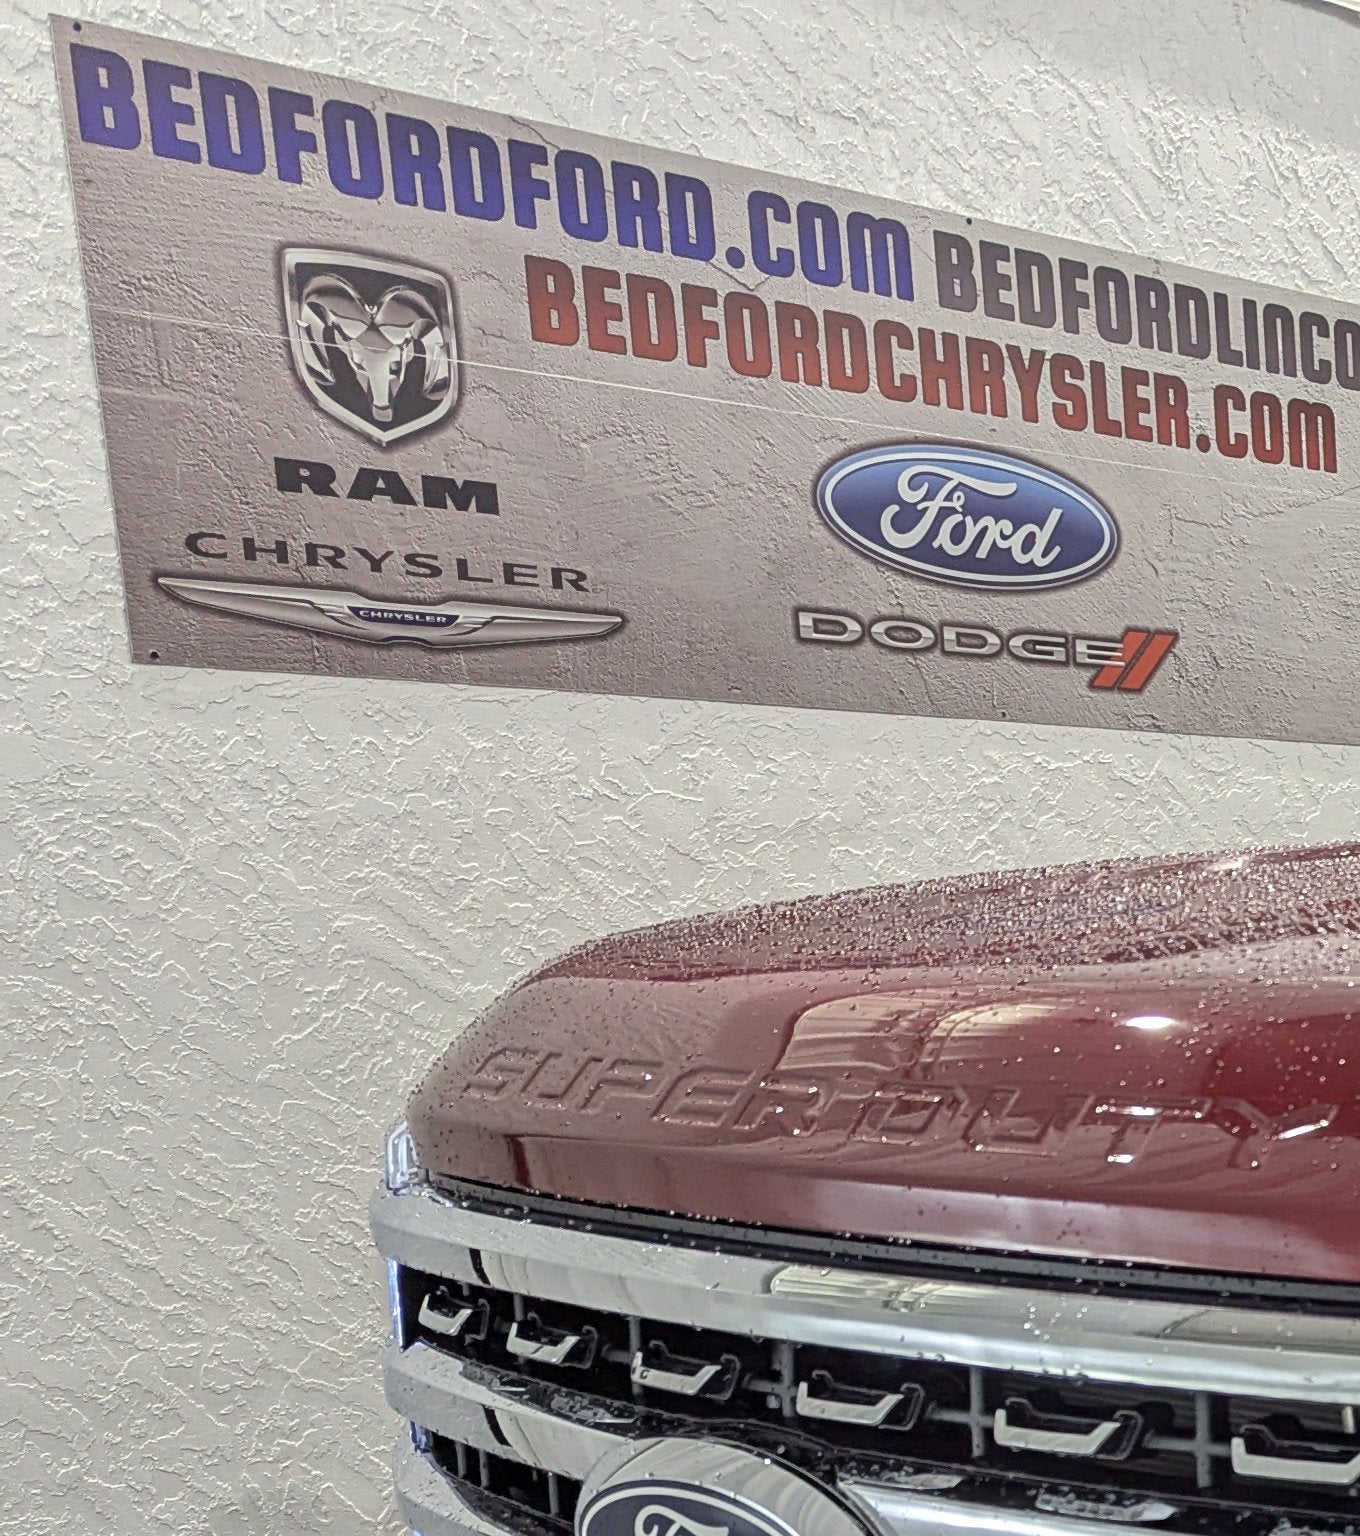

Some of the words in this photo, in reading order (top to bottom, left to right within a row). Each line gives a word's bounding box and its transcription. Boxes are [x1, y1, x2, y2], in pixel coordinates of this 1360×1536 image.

[273, 457, 501, 517] RAM
[880, 463, 1064, 569] Ford
[184, 531, 590, 593] CHRYSLER
[359, 609, 447, 624] CHRYSLER
[796, 611, 1128, 669] DODGE
[463, 1046, 828, 1138] SUPER
[842, 1077, 1339, 1171] DUTY
